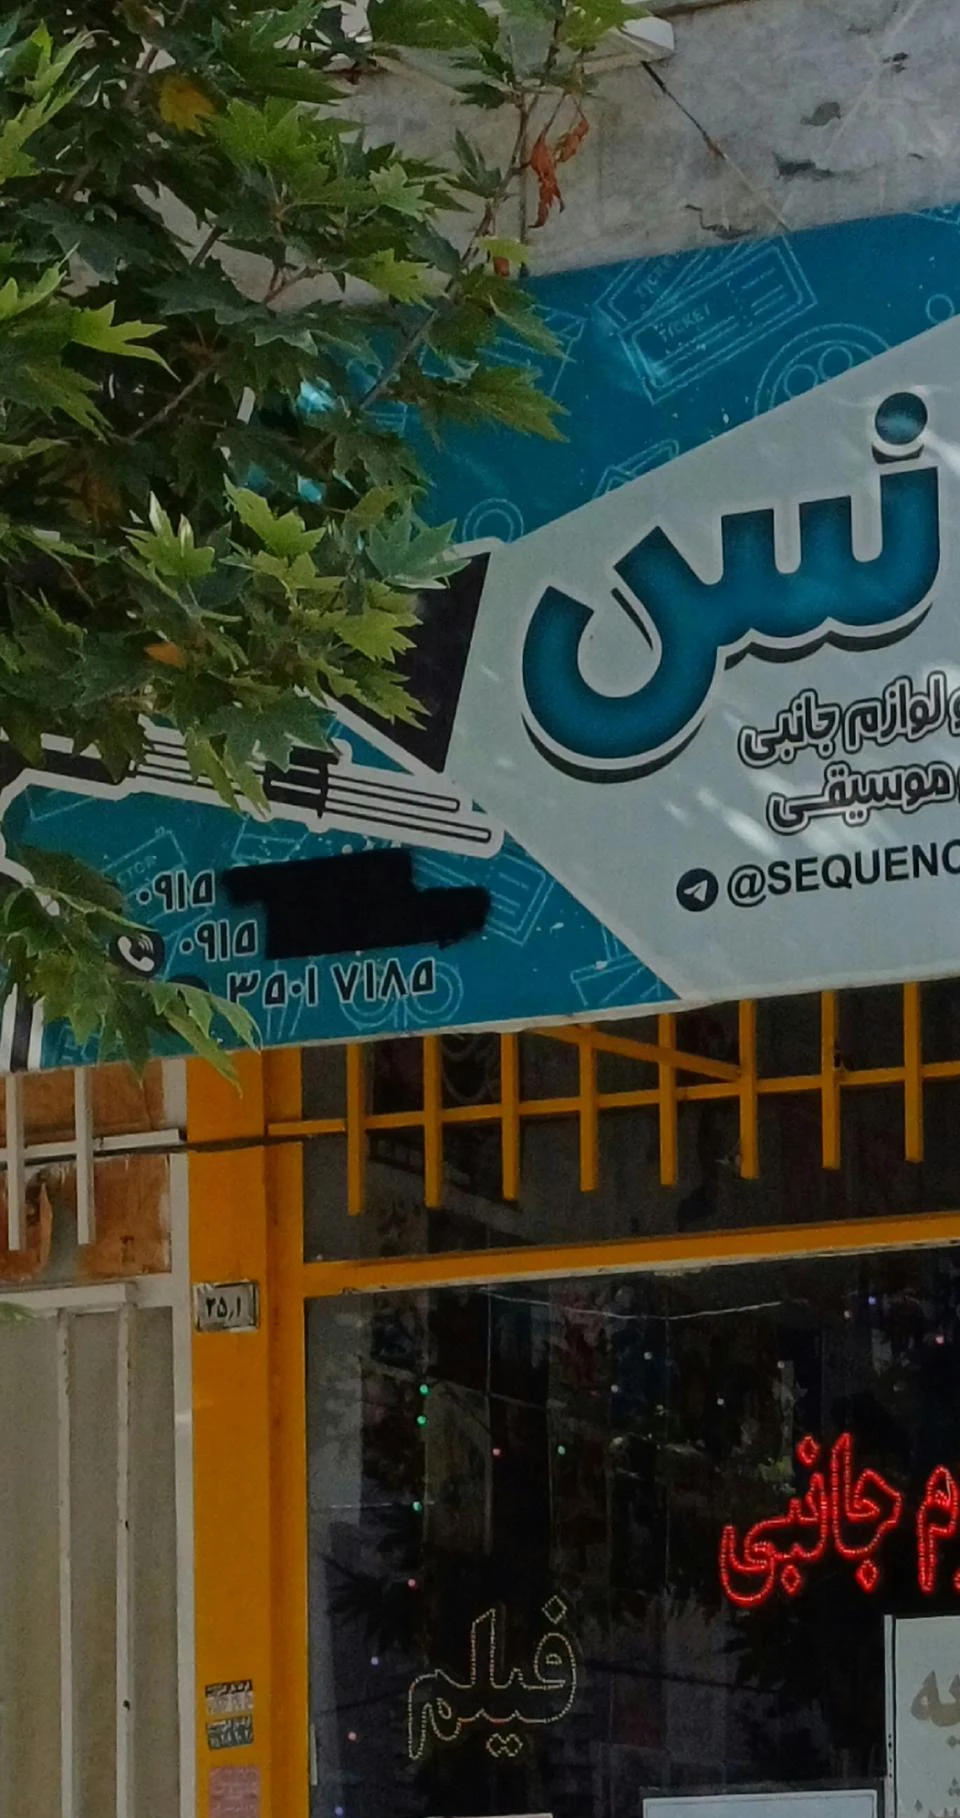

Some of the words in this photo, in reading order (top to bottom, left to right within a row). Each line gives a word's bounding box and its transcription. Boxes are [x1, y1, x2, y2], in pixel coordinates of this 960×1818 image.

[738, 688, 842, 769] جانبی
[844, 670, 947, 753] لوازم
[766, 761, 957, 836] موسیقی
[137, 870, 216, 911] ۰۹۱۵
[179, 920, 258, 962] ۰۹۱۵
[332, 957, 437, 1004] ۷۱۸۵
[716, 1430, 906, 1607] جانبی
[406, 1594, 581, 1761] فیلم
